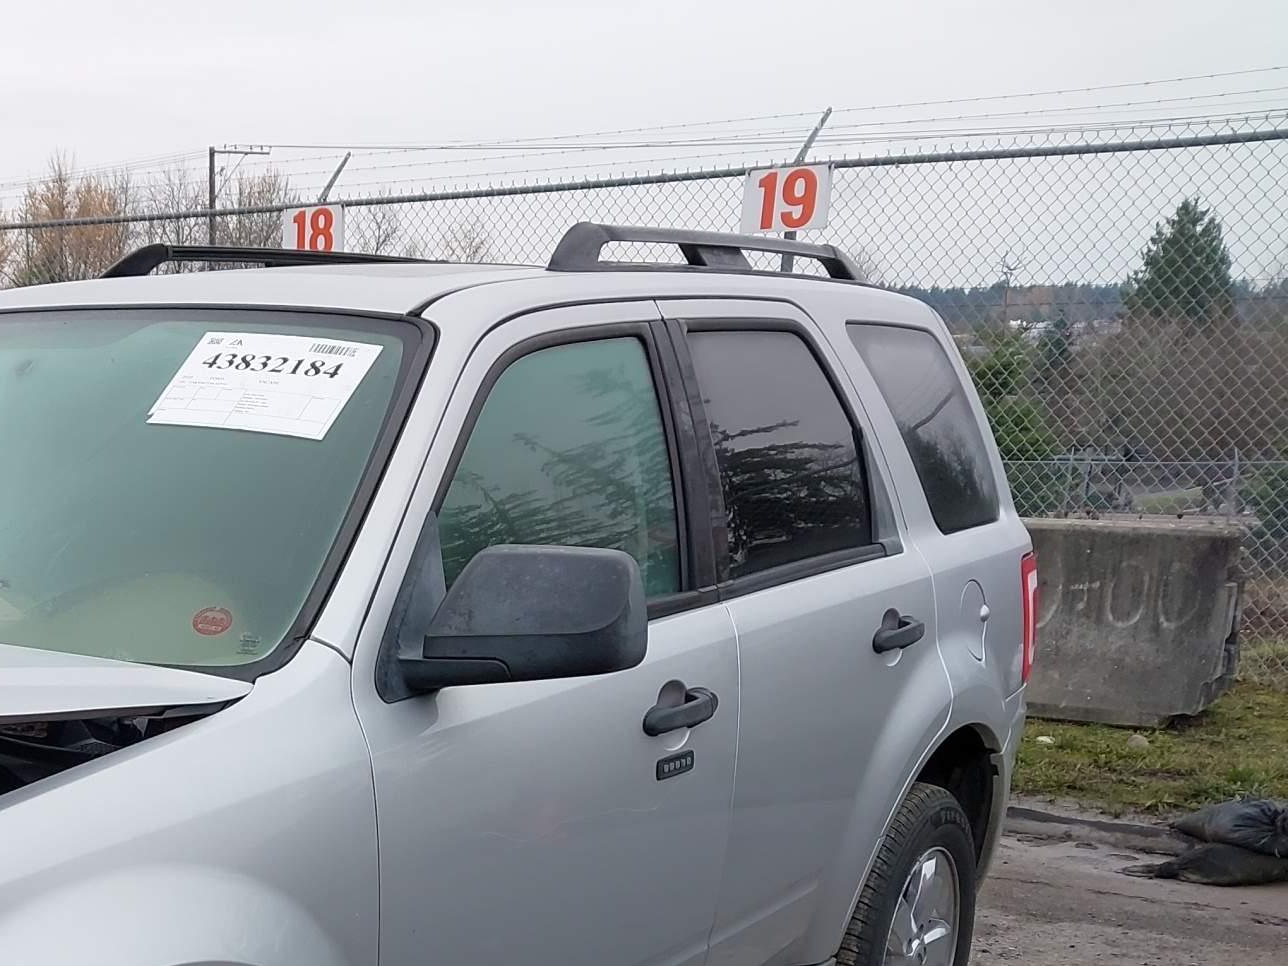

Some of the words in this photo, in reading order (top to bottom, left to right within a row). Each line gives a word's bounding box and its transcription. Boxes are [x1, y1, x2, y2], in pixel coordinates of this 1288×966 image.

[758, 168, 818, 231] 19
[292, 206, 334, 252] 18
[201, 352, 344, 379] 43832184
